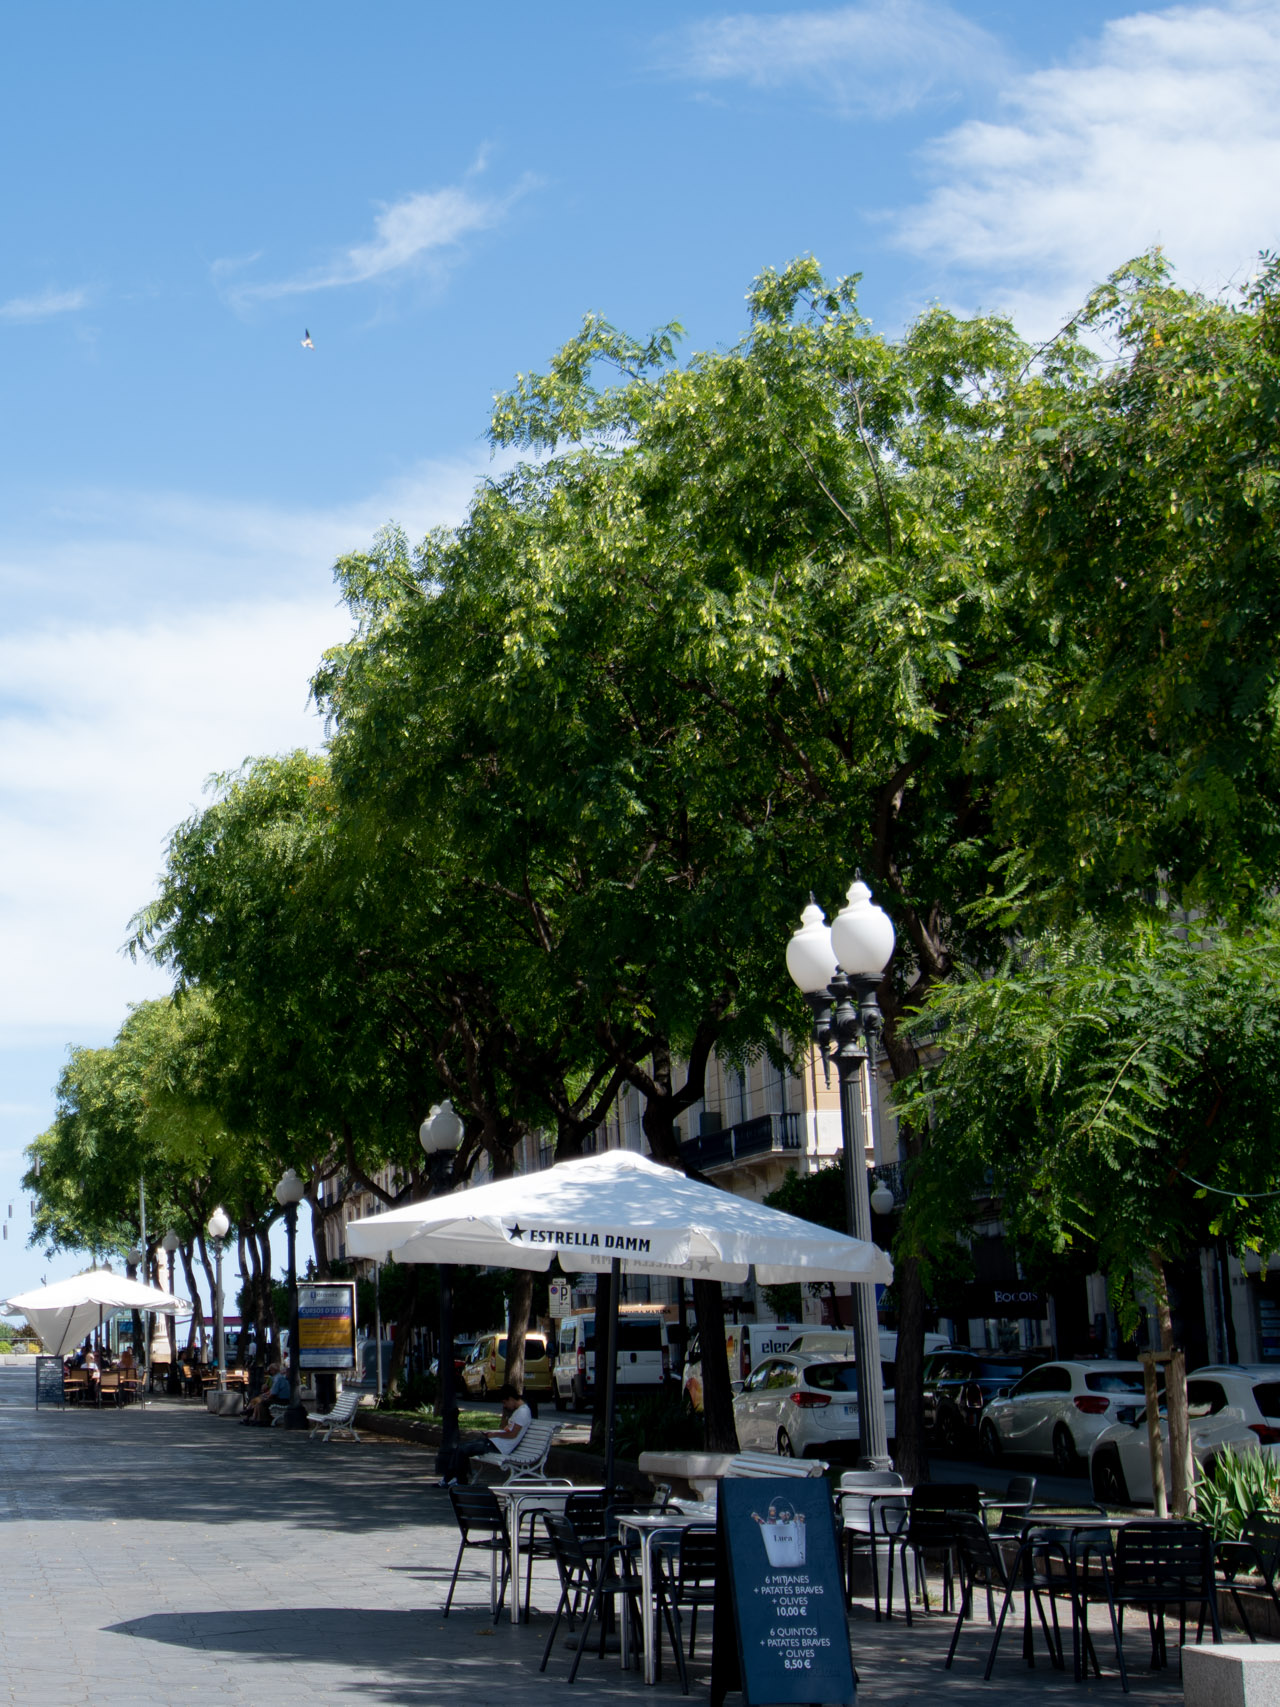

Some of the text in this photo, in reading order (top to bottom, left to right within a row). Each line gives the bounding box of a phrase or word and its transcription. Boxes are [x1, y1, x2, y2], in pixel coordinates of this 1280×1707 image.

[530, 1229, 651, 1253] ESTRELLA DAMM
[765, 1575, 810, 1586] 6 MITJANES
[761, 1586, 793, 1595] PATATES
[795, 1585, 824, 1594] BRAVES
[779, 1597, 809, 1606] OLIVES
[776, 1606, 799, 1617] 10,00
[770, 1627, 817, 1637] 6 QUINTOS
[767, 1639, 800, 1647] PATATES
[801, 1638, 831, 1647] BRAVES
[786, 1649, 815, 1658] OLIVES
[784, 1659, 803, 1670] 8,50
